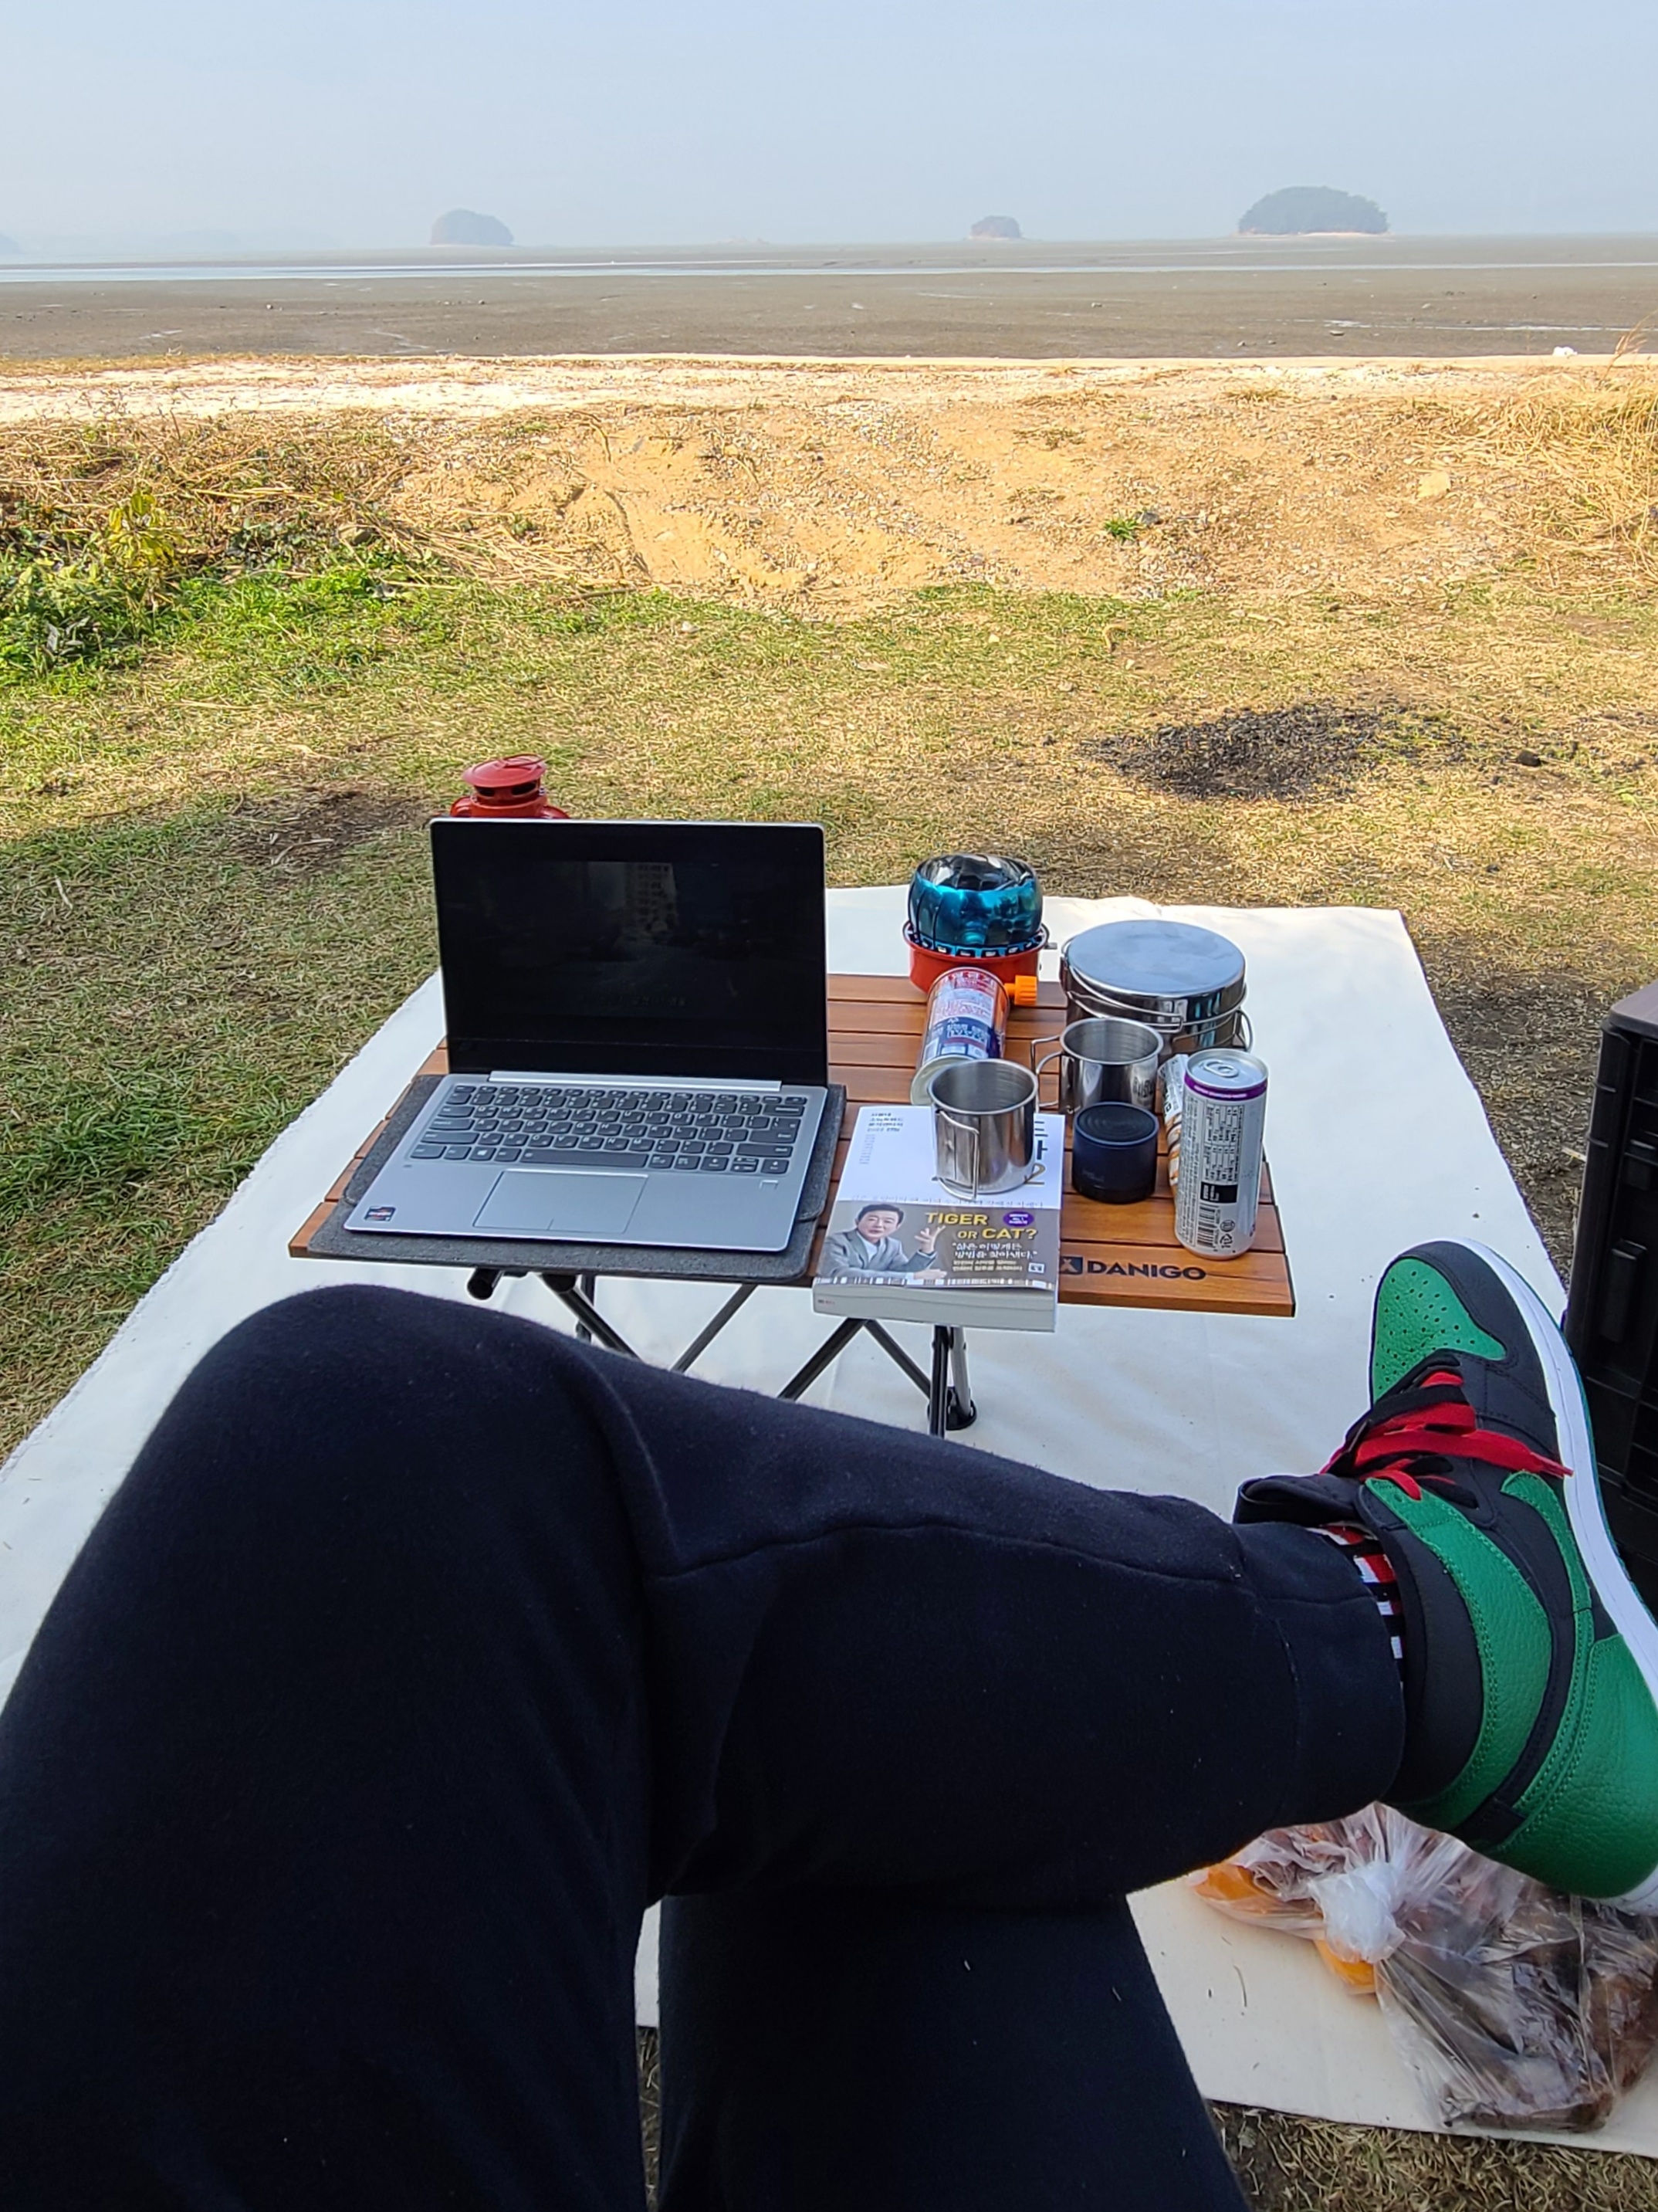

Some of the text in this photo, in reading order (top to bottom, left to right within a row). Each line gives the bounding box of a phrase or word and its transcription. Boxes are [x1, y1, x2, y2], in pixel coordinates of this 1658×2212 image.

[925, 1212, 989, 1225] TIGER
[957, 1228, 1037, 1240] OR CAT?
[1087, 1260, 1206, 1280] DANIGO
